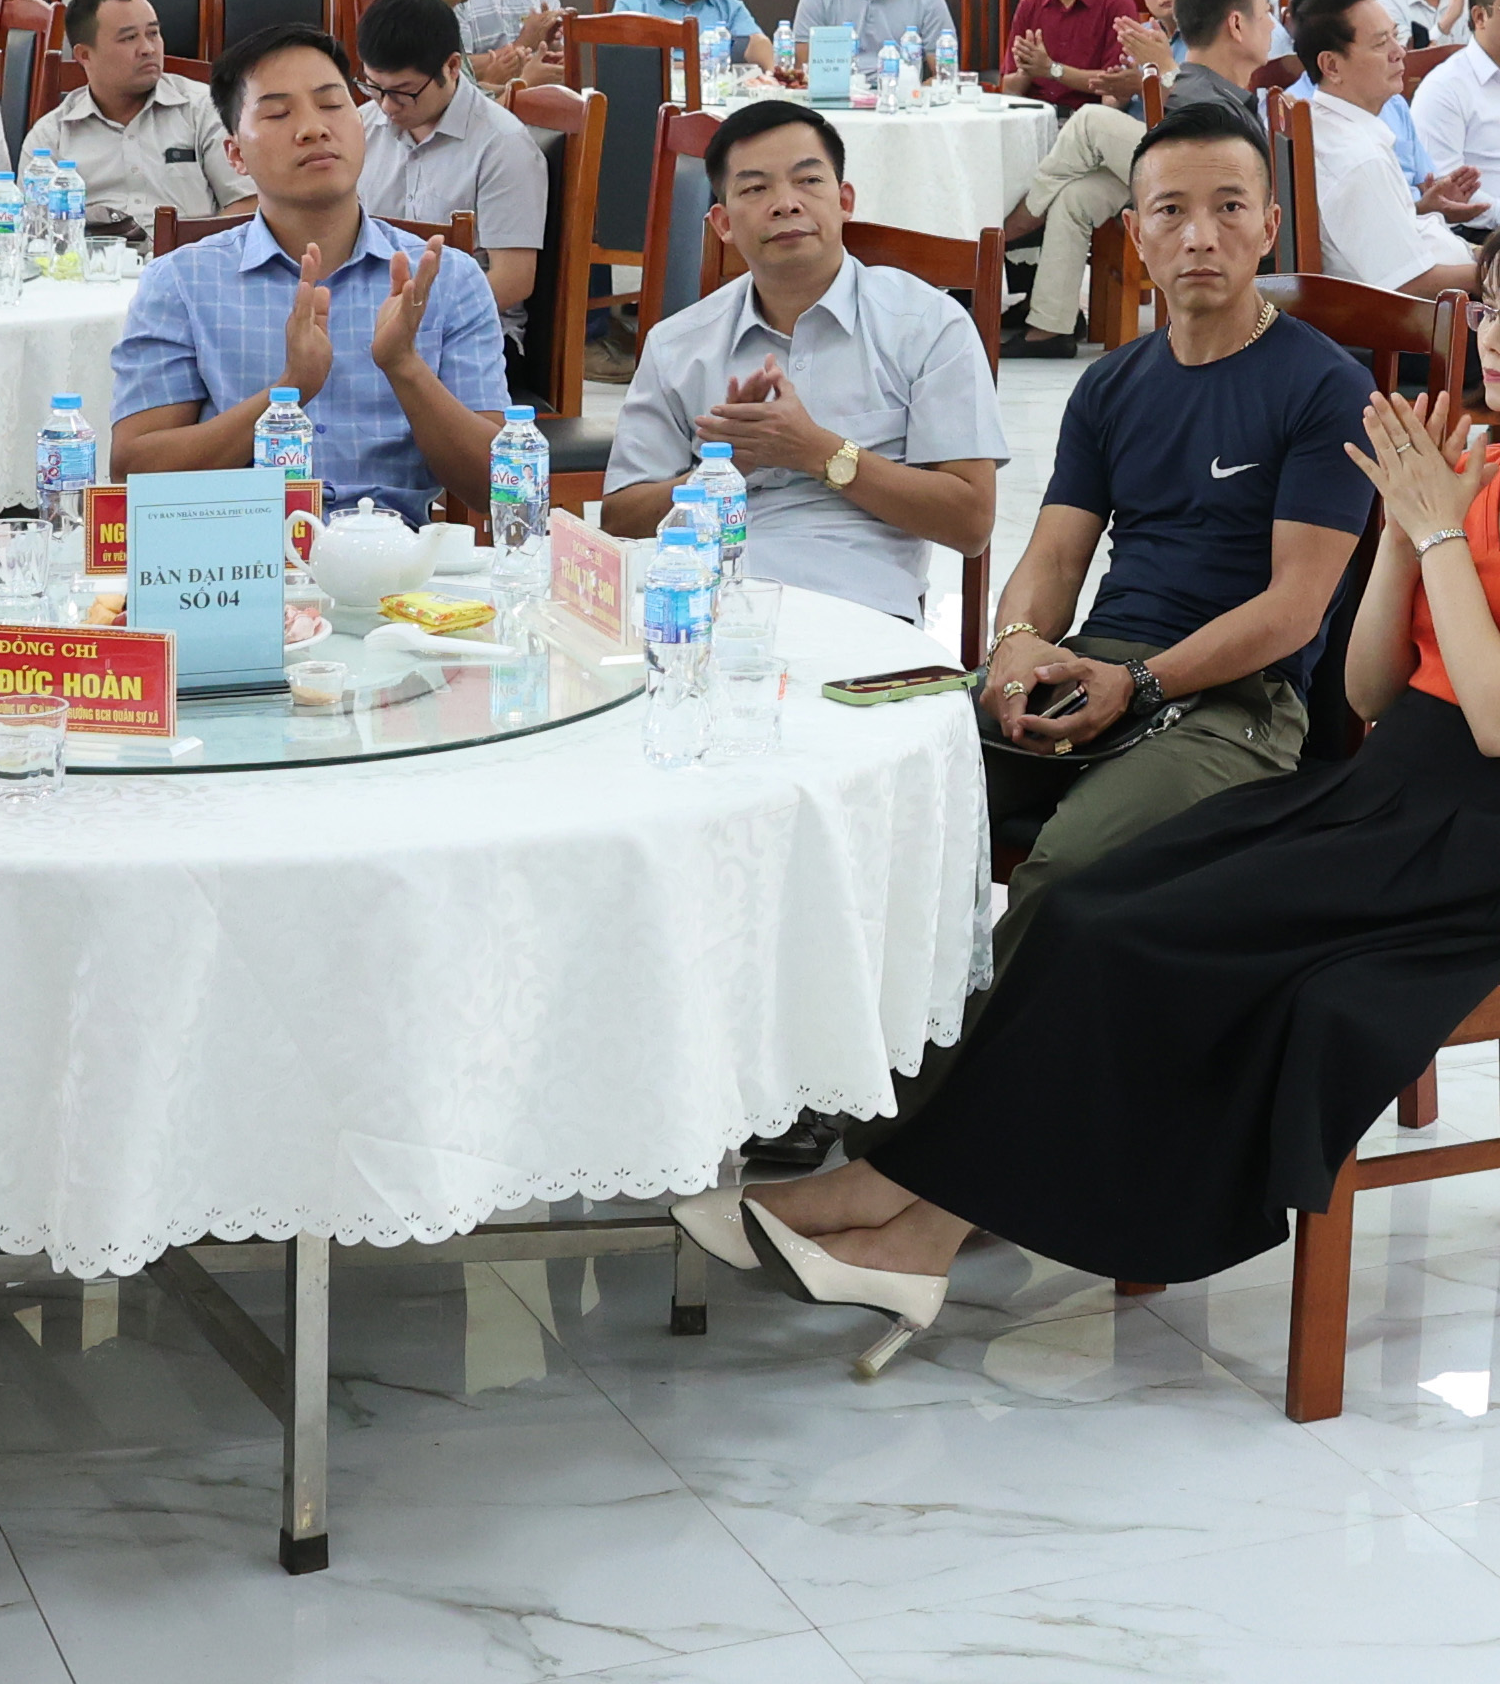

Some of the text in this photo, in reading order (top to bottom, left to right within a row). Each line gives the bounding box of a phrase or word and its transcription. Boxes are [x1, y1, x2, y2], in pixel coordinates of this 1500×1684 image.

[140, 566, 181, 586] BÀN
[188, 566, 224, 587] ĐẠI
[179, 586, 240, 610] SỐ 04
[61, 642, 98, 659] CHÍ
[63, 669, 143, 701] HOÀN
[95, 710, 111, 721] BCH
[113, 708, 135, 723] QUÂN
